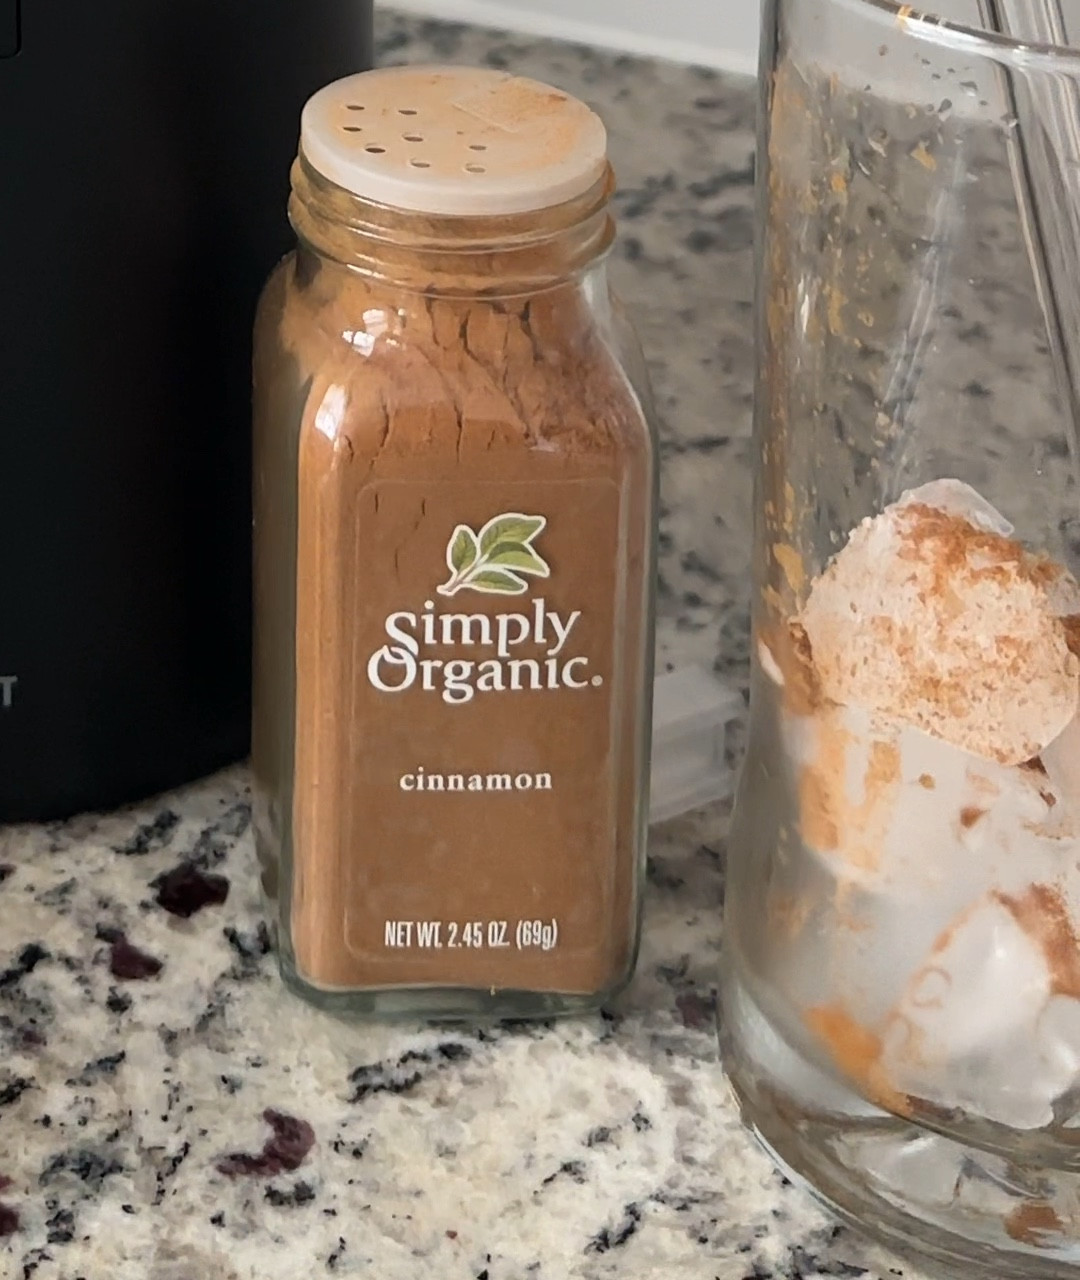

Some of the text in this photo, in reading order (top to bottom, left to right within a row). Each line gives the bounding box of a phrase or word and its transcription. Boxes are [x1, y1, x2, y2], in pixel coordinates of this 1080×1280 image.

[385, 598, 582, 657] Simply
[399, 766, 553, 791] cinnamon
[384, 920, 413, 948] NET
[417, 921, 443, 948] WT.
[447, 921, 483, 948] 2.45
[516, 918, 558, 951] (69g)
